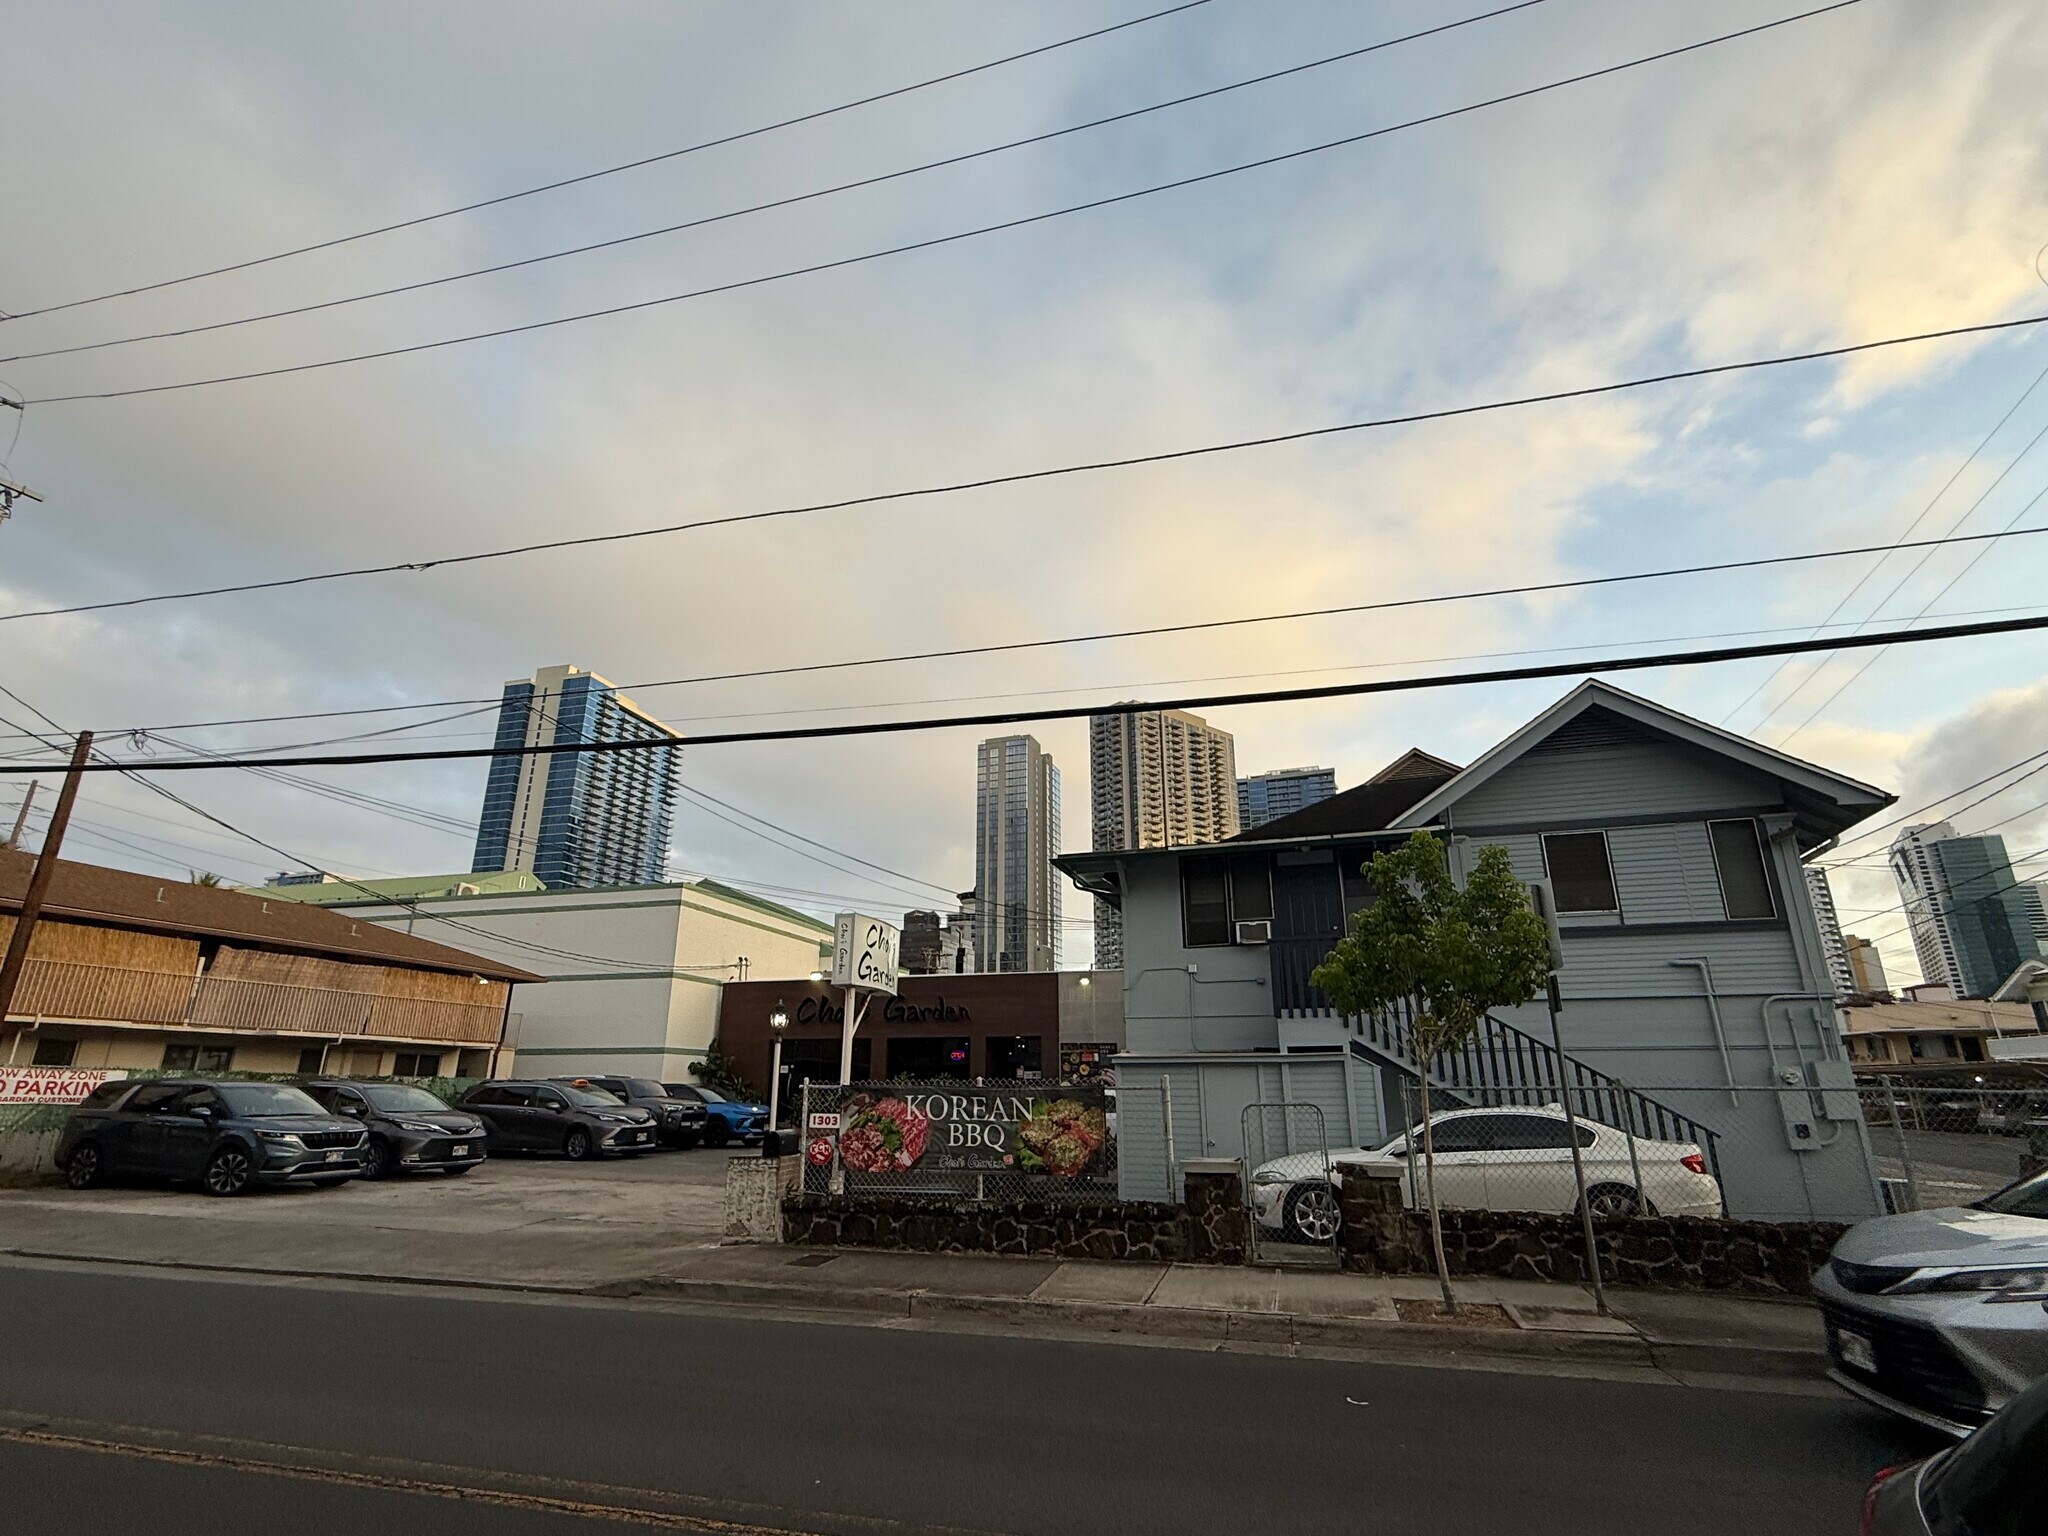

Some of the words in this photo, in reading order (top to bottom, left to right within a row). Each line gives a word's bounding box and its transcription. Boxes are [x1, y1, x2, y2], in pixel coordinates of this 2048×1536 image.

[857, 951, 895, 988] Garden
[883, 994, 972, 1024] Garden
[22, 1069, 65, 1080] AWAY
[68, 1070, 107, 1081] ZONE
[812, 1115, 838, 1126] 1303
[904, 1094, 1035, 1123] KOREAN
[948, 1123, 1005, 1152] BBQ
[967, 1153, 1006, 1169] Garden
